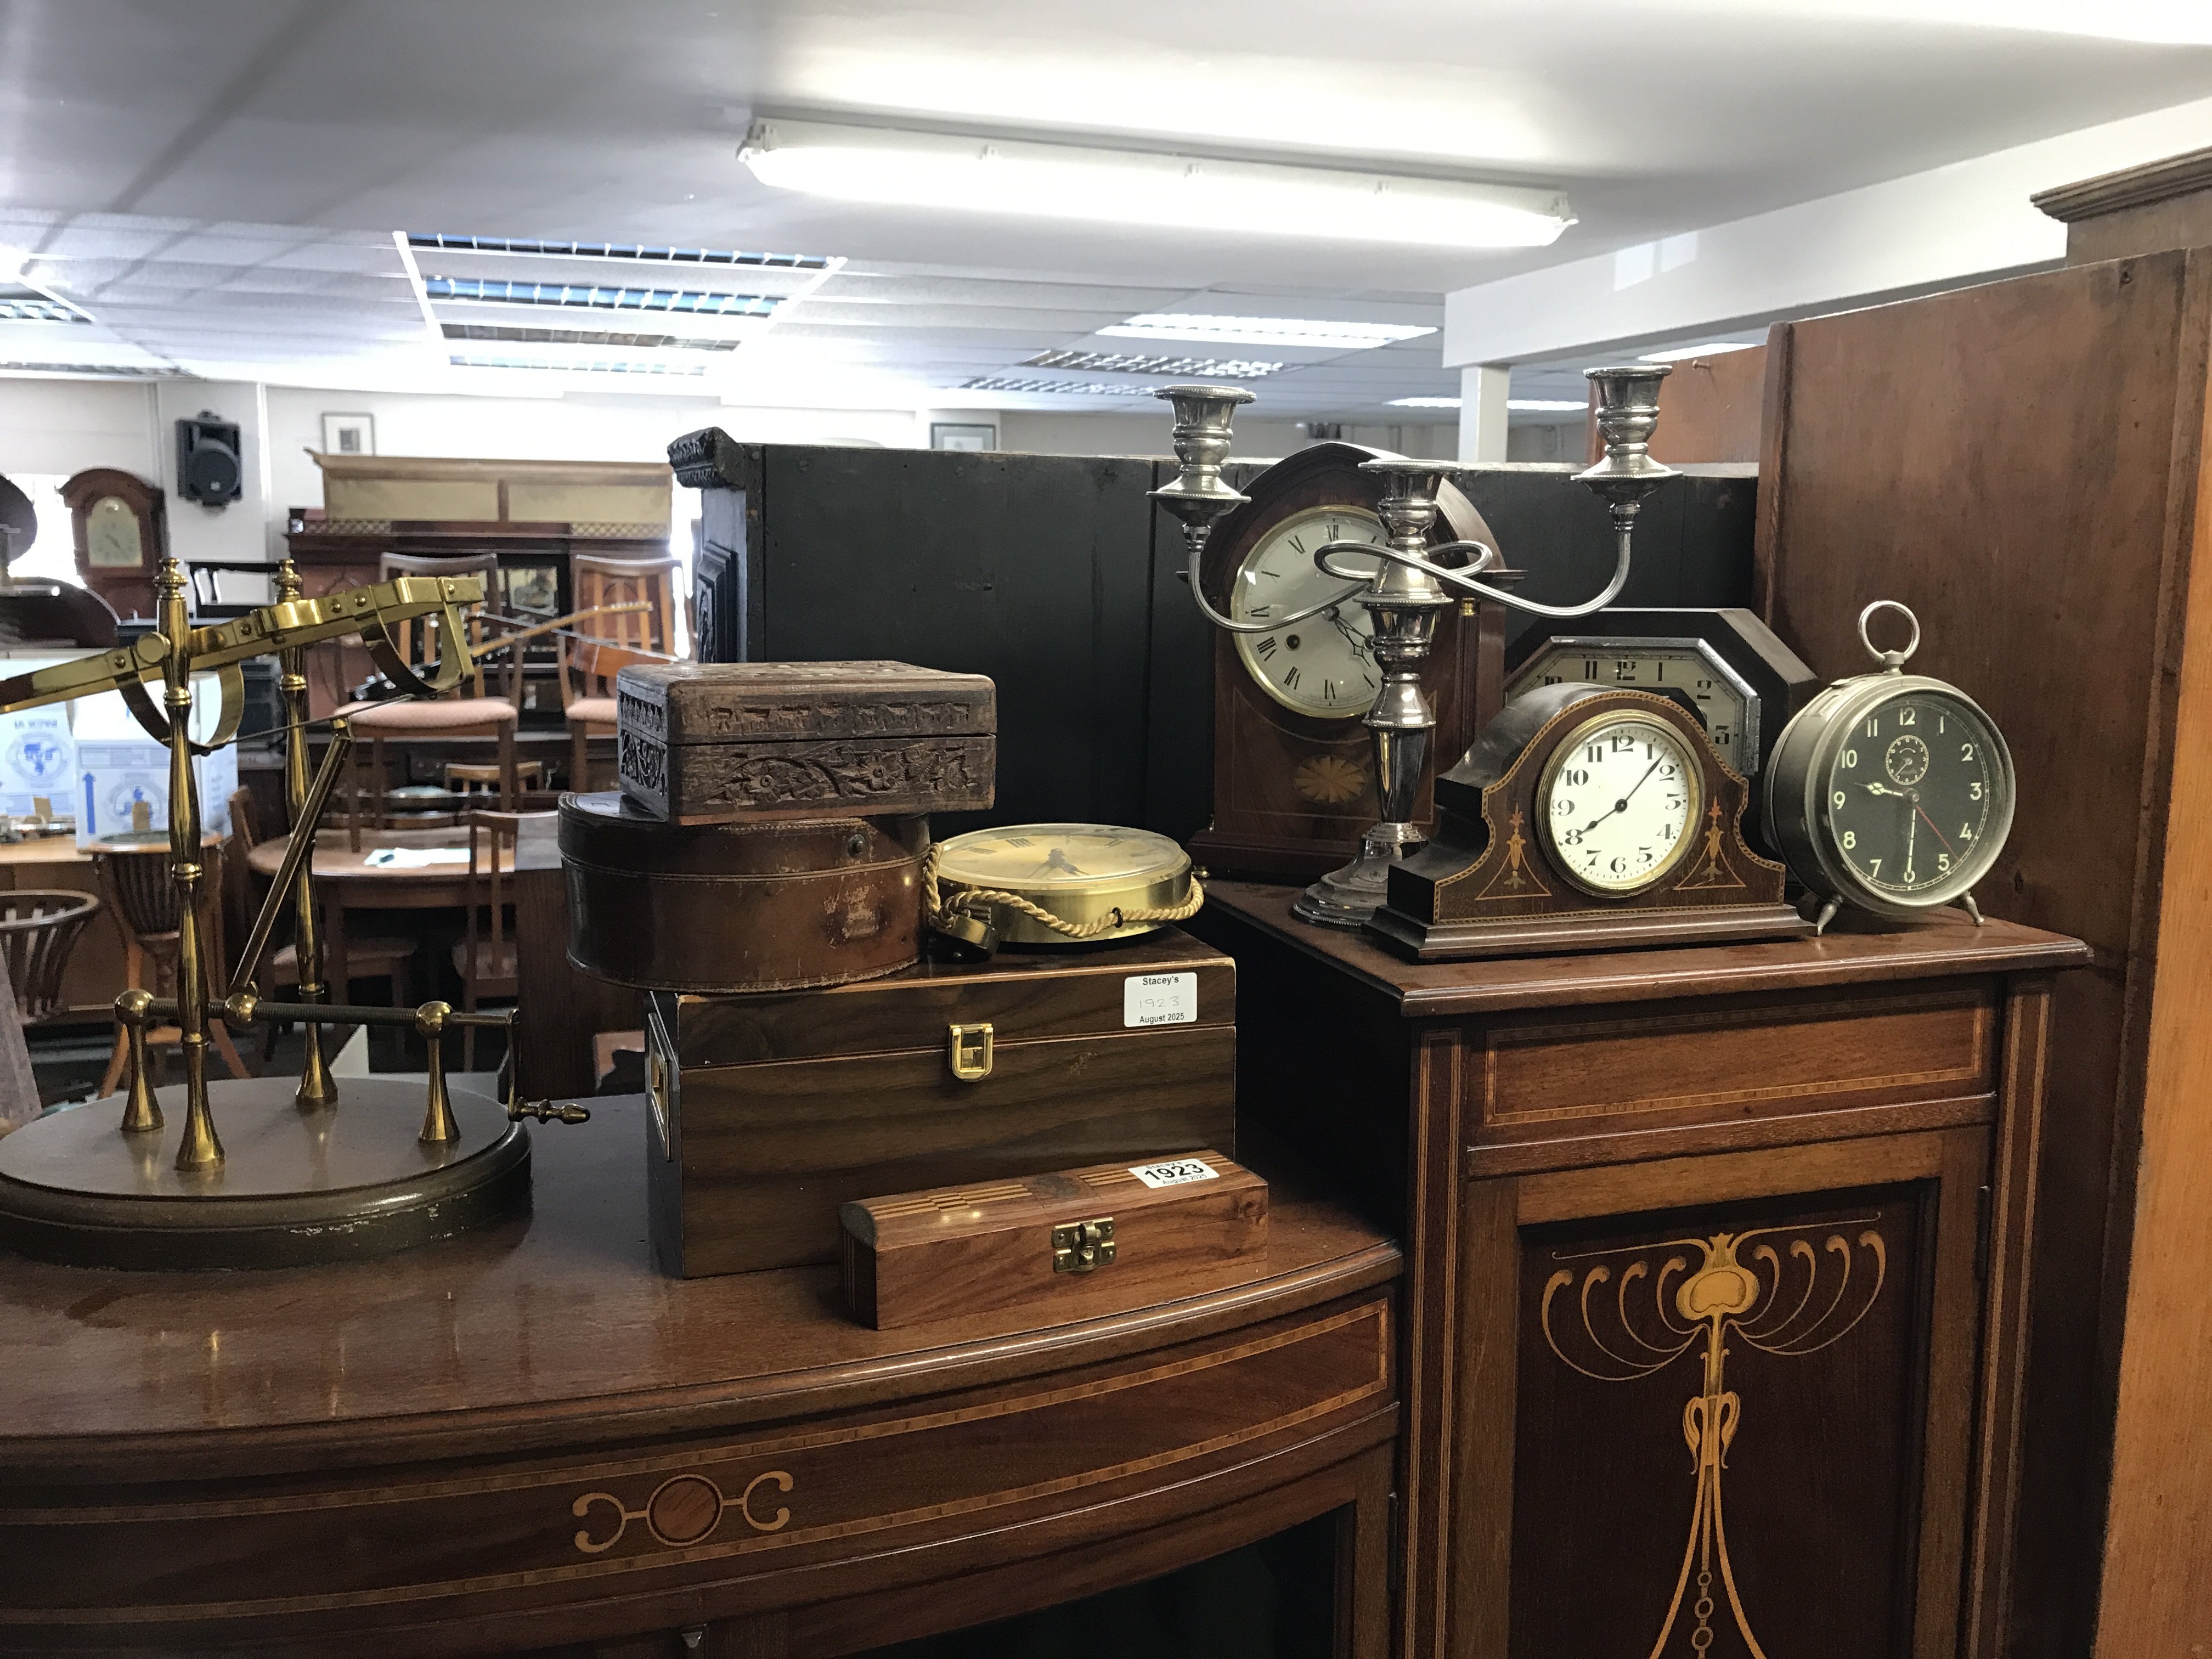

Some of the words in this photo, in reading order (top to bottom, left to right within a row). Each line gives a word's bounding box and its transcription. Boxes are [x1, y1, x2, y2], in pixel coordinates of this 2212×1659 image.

[1585, 661, 1597, 679] 11
[1617, 661, 1636, 680] 12
[1658, 662, 1663, 681] 1
[1697, 680, 1711, 699] 2
[1899, 708, 1916, 726] 12
[1939, 716, 1944, 733] 1
[1716, 725, 1730, 744] 3
[1867, 719, 1877, 738] 11
[1612, 735, 1634, 752] 12
[1647, 743, 1652, 759] 1
[1588, 746, 1602, 762] 11
[1842, 750, 1857, 769] 10
[1962, 744, 1973, 761] 2
[1566, 769, 1588, 786] 10
[1659, 765, 1675, 781] 2
[1970, 782, 1982, 800] 3
[1558, 800, 1575, 816] 9
[1666, 794, 1681, 810] 3
[1833, 792, 1846, 810] 9
[1565, 830, 1583, 845] 8
[1656, 824, 1674, 839] 4
[1959, 822, 1972, 840] 4
[1844, 831, 1856, 849] 8
[1587, 850, 1601, 866] 7
[1637, 847, 1652, 862] 5
[1938, 854, 1950, 872] 5
[1611, 857, 1626, 872] 6
[1870, 859, 1882, 878] 7
[1143, 976, 1180, 985] Stacey's
[1139, 996, 1180, 1008] 1923
[1139, 1014, 1165, 1024] August
[1168, 1013, 1184, 1021] 2025
[1144, 1164, 1204, 1180] 1923
[1163, 1177, 1189, 1185] August
